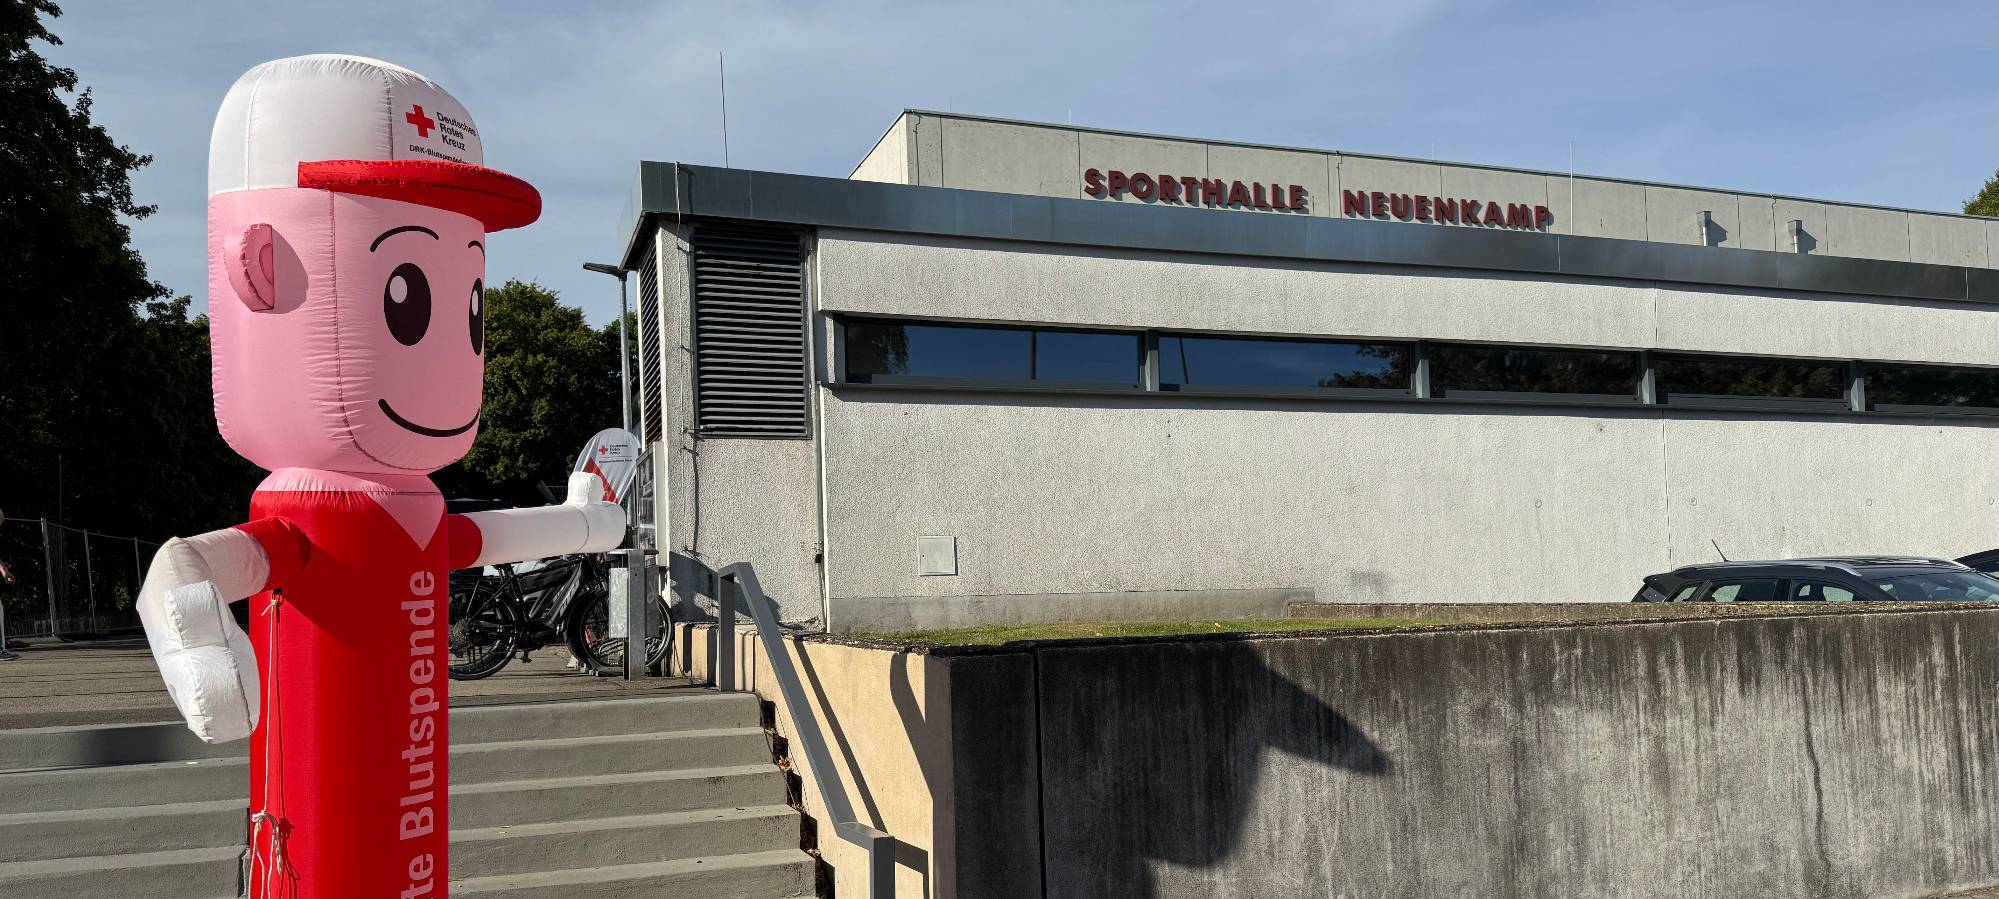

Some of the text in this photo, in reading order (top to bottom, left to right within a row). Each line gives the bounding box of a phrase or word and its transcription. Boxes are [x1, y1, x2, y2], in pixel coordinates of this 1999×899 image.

[436, 111, 477, 137] Deutsches
[440, 123, 464, 140] Rotes
[442, 134, 466, 151] Kreuz
[1083, 167, 1551, 230] SPORTHALLE NEUENKAMP
[400, 570, 440, 899] te Blutspende
